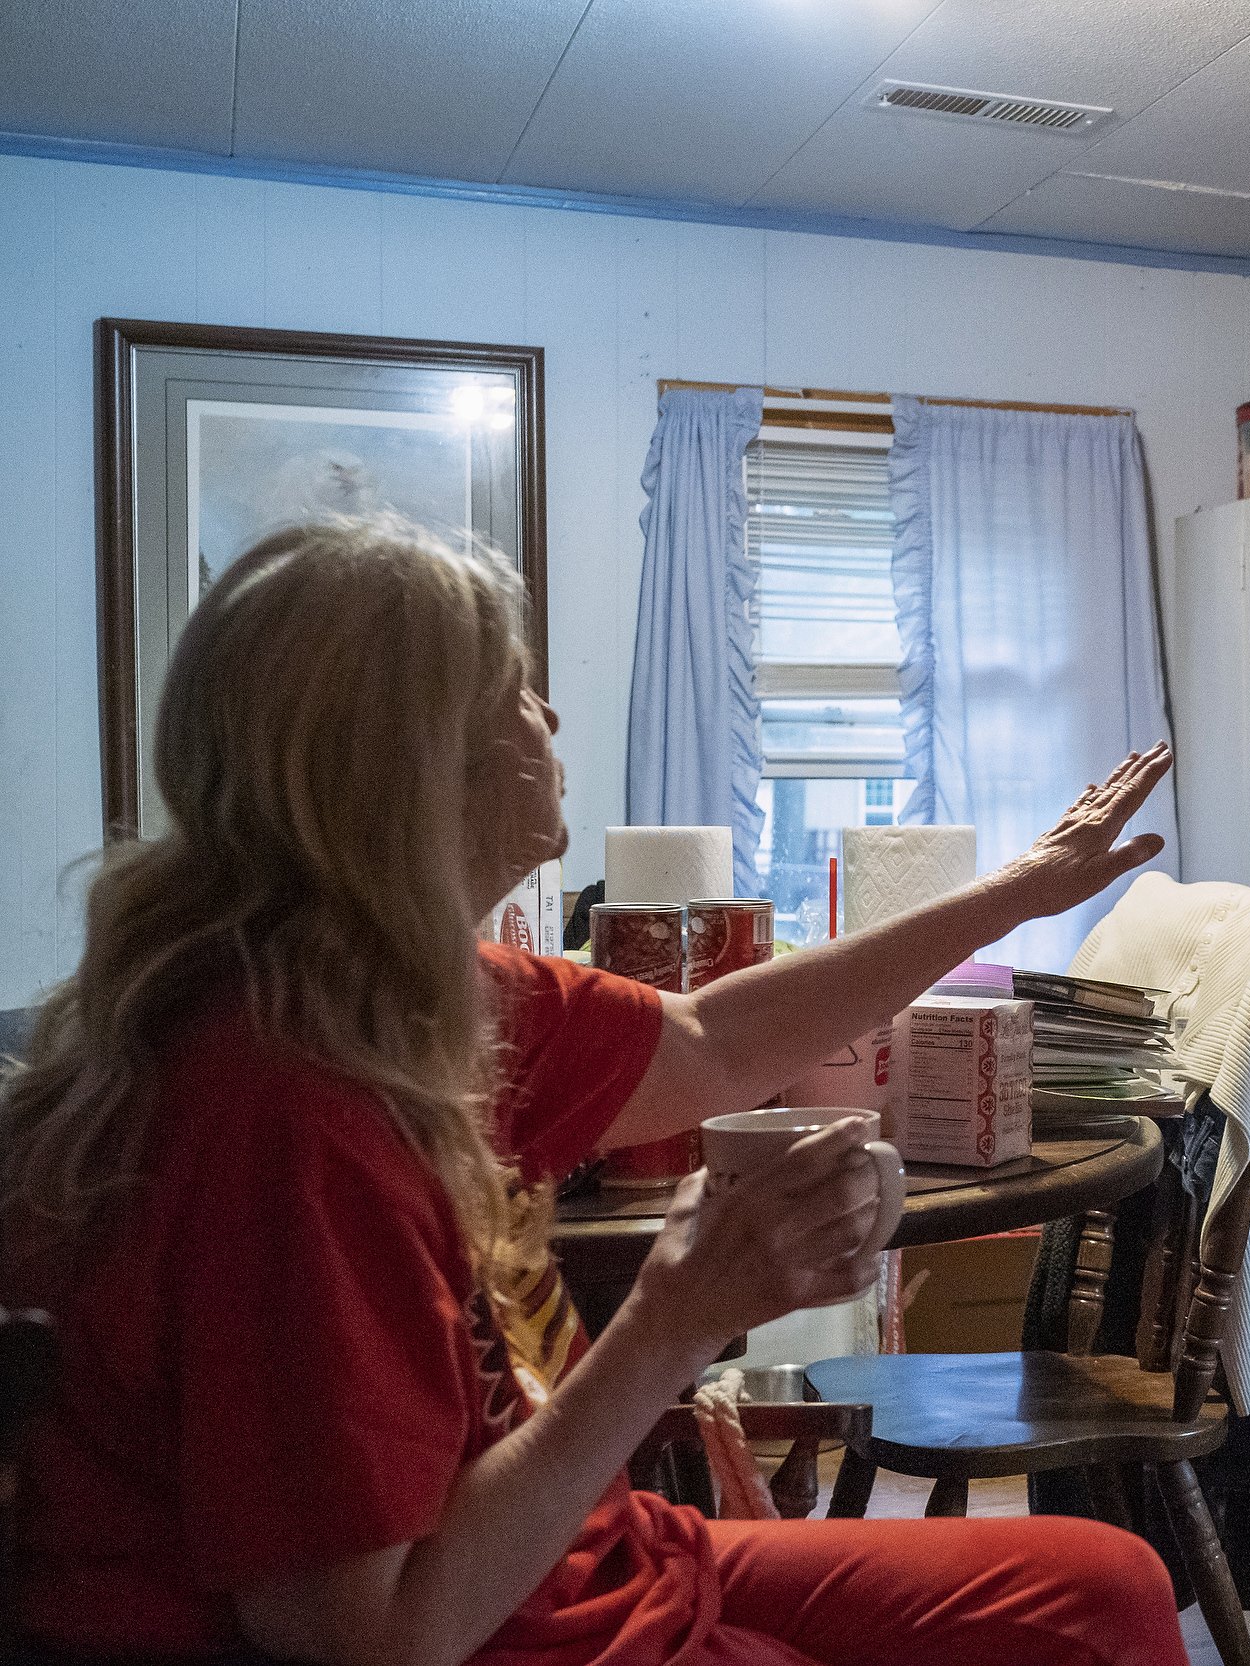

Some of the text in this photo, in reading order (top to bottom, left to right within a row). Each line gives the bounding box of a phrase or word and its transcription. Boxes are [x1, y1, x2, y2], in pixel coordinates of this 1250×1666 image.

[515, 916, 530, 952] BOO
[911, 1013, 974, 1024] Nutrition Facts
[959, 1040, 973, 1048] 130
